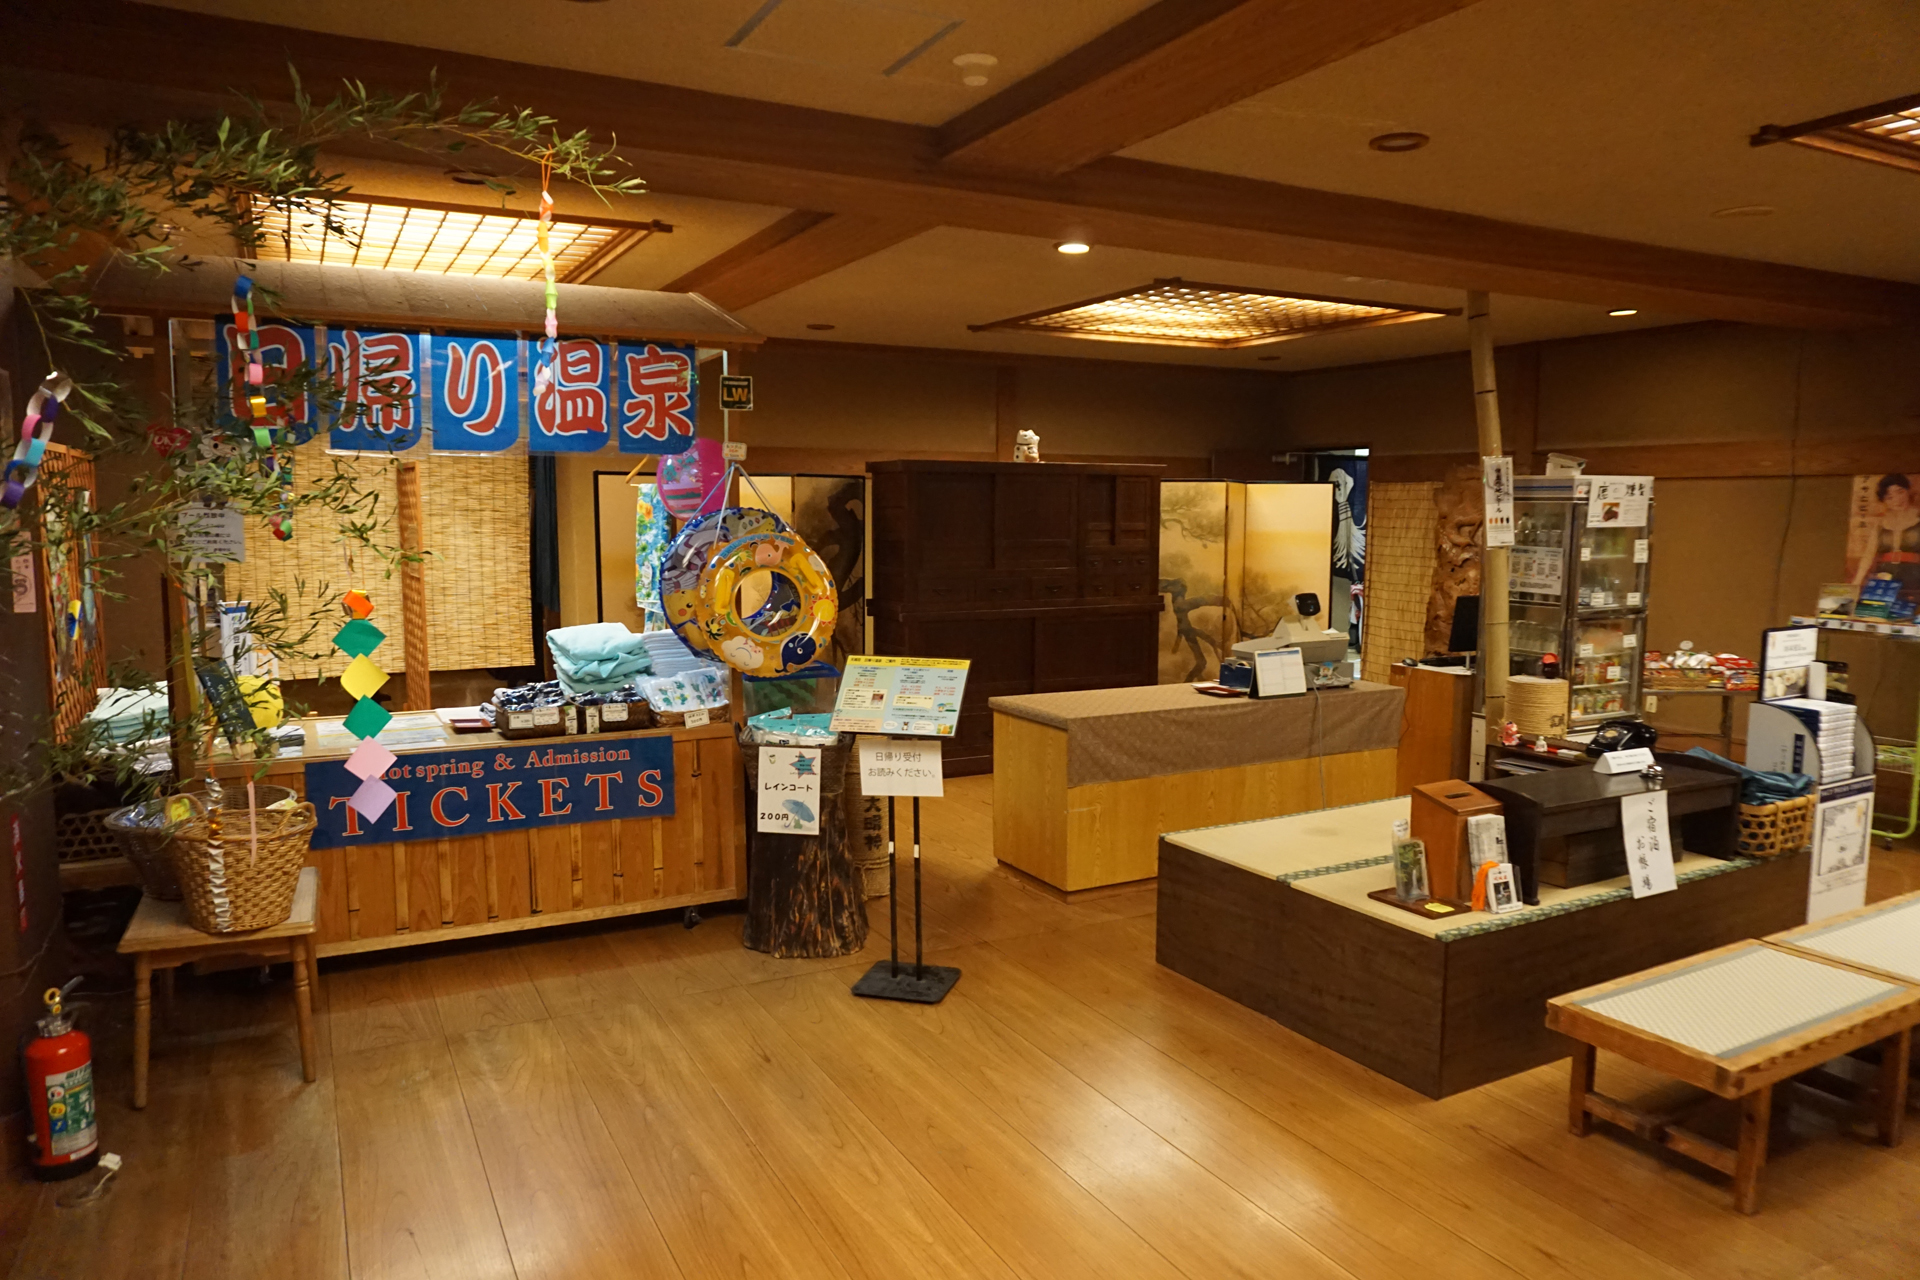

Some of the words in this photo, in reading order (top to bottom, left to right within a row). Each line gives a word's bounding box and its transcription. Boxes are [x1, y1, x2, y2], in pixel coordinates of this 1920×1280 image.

[223, 324, 694, 441] 日帰り温泉
[723, 387, 748, 402] LW
[379, 764, 412, 781] ot
[415, 758, 484, 783] spring
[494, 753, 516, 771] &
[524, 746, 631, 769] Admission
[875, 751, 922, 763] 日帰り受付
[867, 767, 936, 778] お読みください。
[764, 782, 813, 792] レインコート
[328, 768, 664, 837] TICKETS
